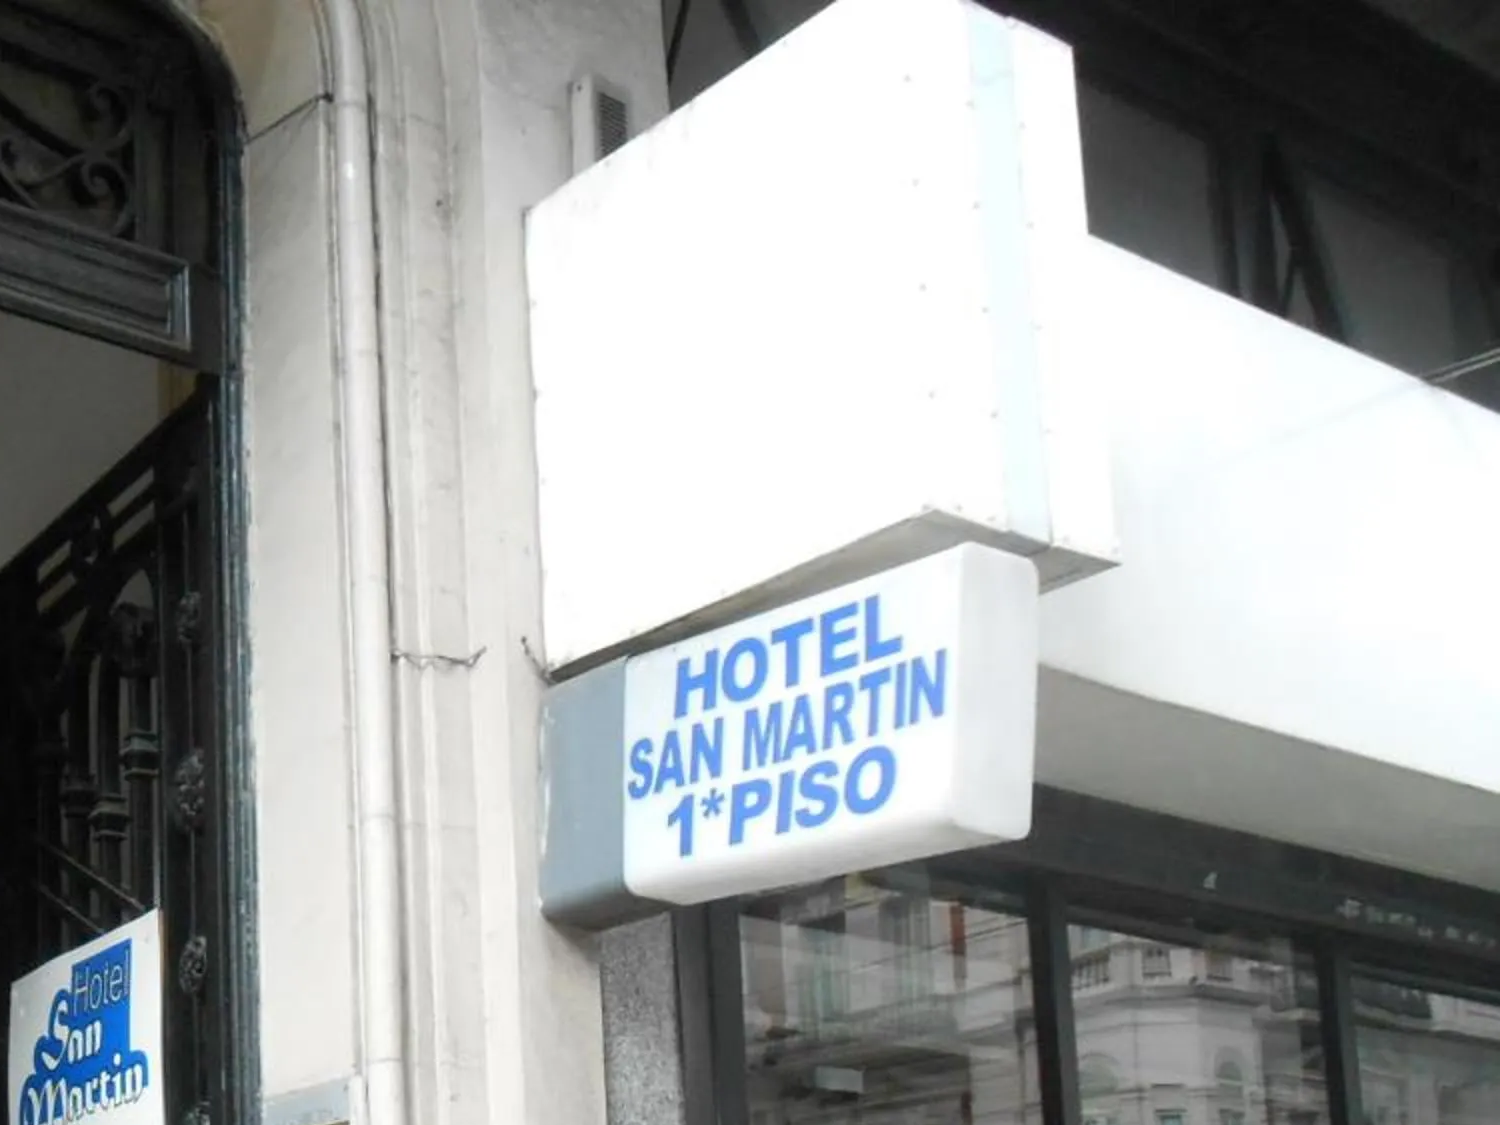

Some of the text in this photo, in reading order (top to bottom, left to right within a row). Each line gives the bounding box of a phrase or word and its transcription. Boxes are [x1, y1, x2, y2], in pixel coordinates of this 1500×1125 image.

[673, 593, 904, 720] HOTEL
[627, 647, 948, 800] SAN MARTIN
[72, 951, 129, 1017] Hotel
[41, 999, 101, 1072] San
